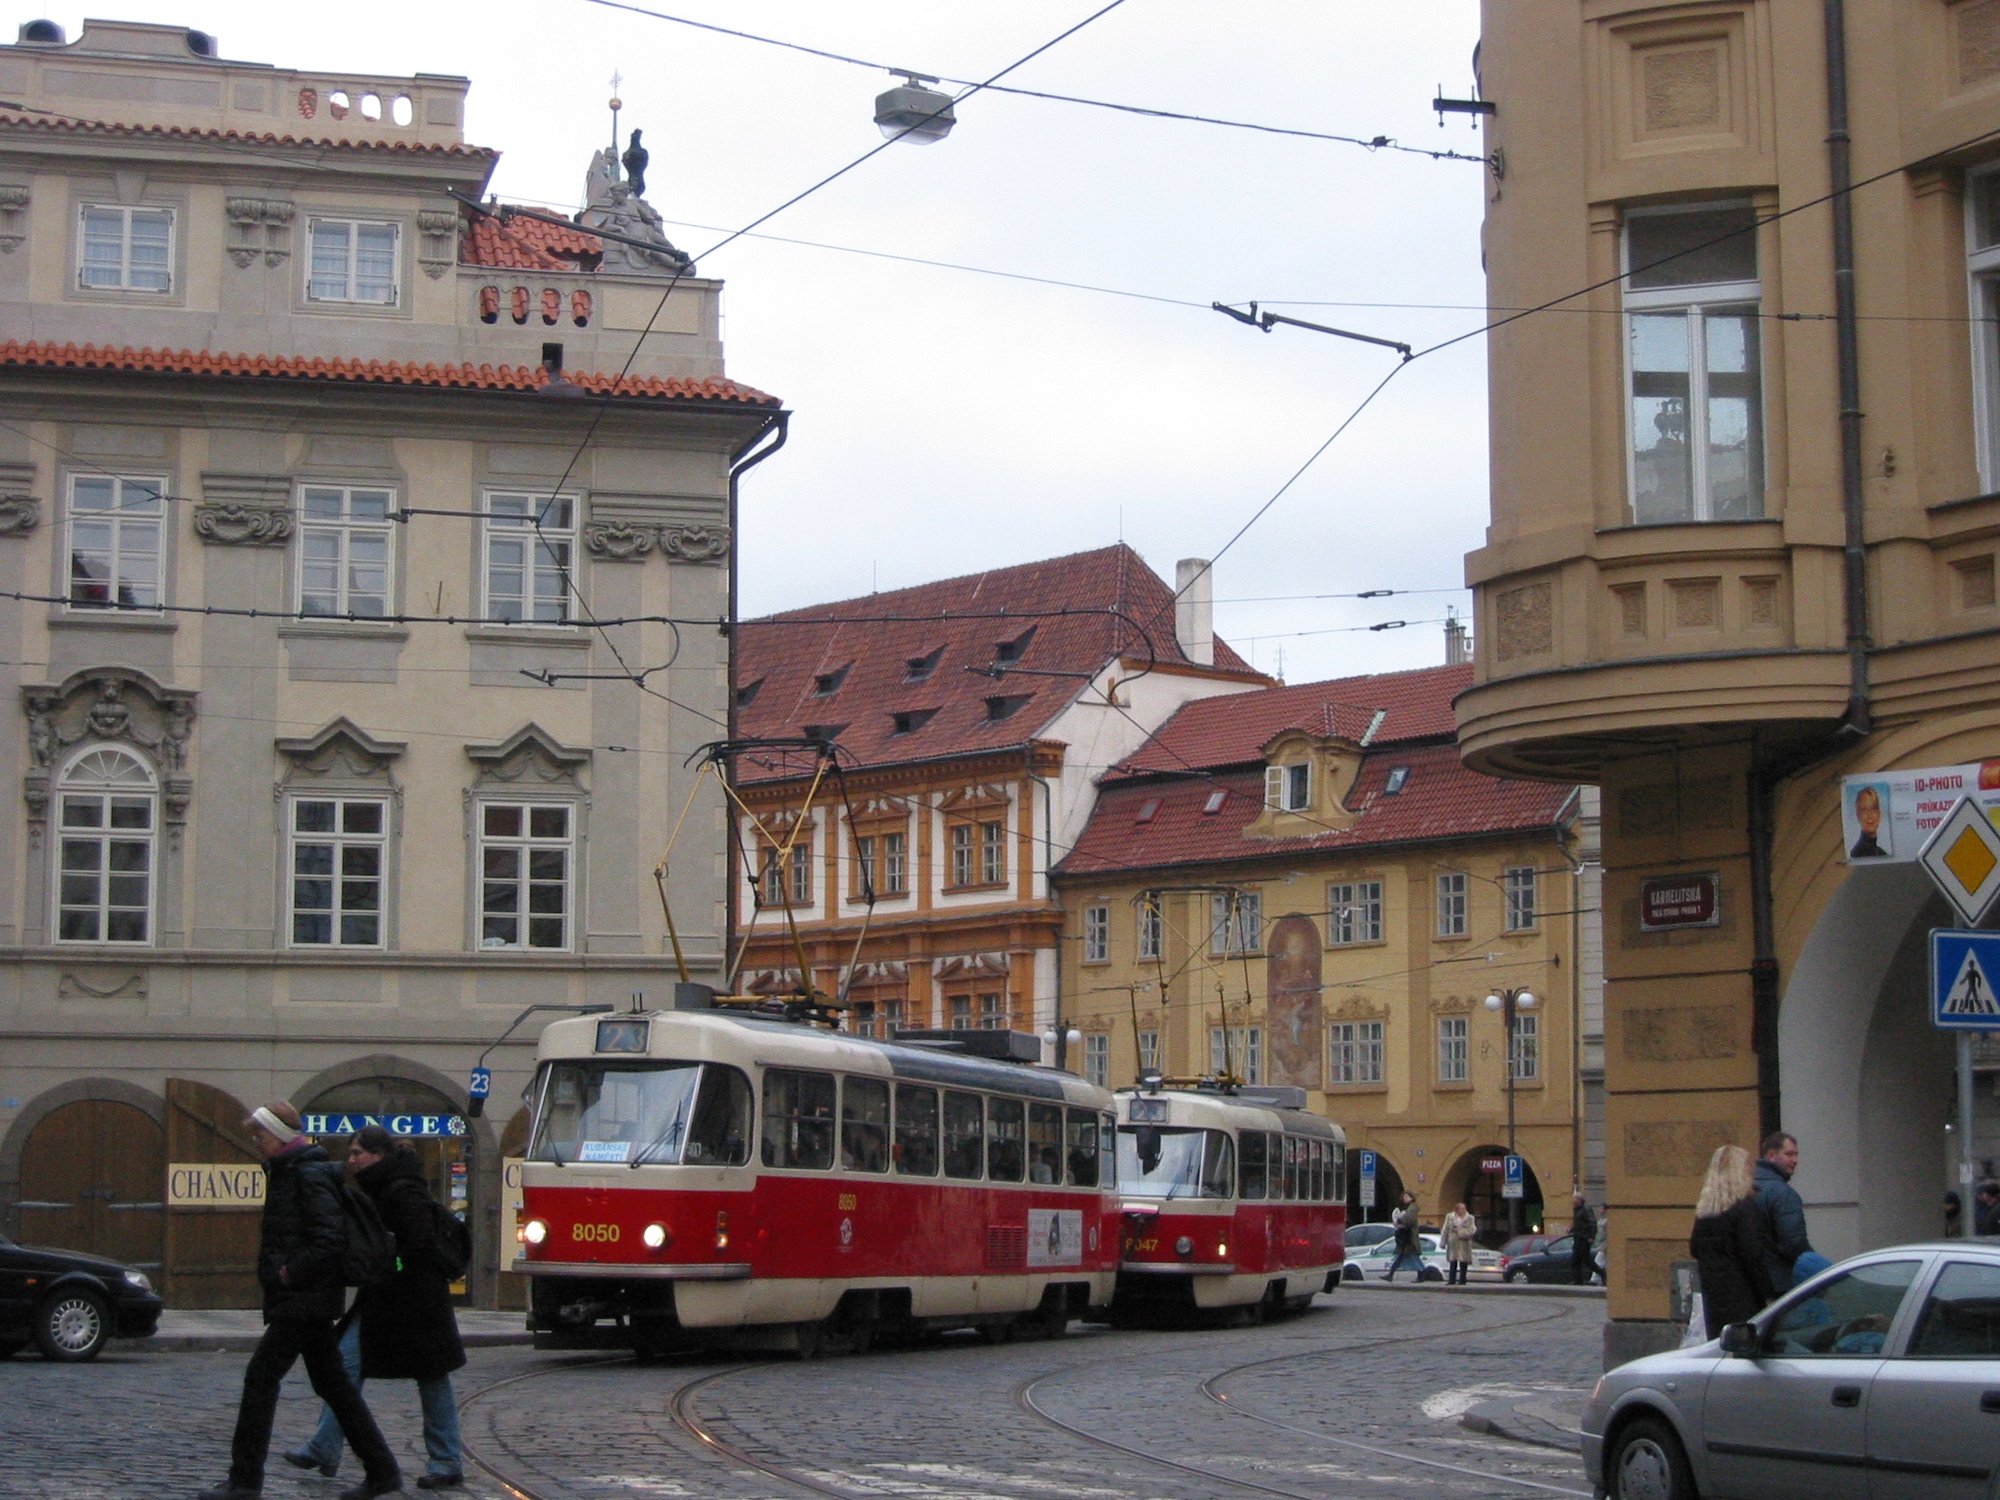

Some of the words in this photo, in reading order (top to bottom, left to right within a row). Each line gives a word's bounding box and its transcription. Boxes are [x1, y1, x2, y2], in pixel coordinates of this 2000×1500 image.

[1914, 774, 1963, 793] ID-PHOTO
[604, 1024, 647, 1052] 23
[470, 1073, 489, 1093] 23
[305, 1115, 441, 1134] HANGE
[1364, 1154, 1373, 1170] P
[1482, 1160, 1502, 1169] PIZZA
[1509, 1159, 1518, 1175] P
[171, 1170, 264, 1199] CHANGE
[572, 1223, 621, 1242] 8050
